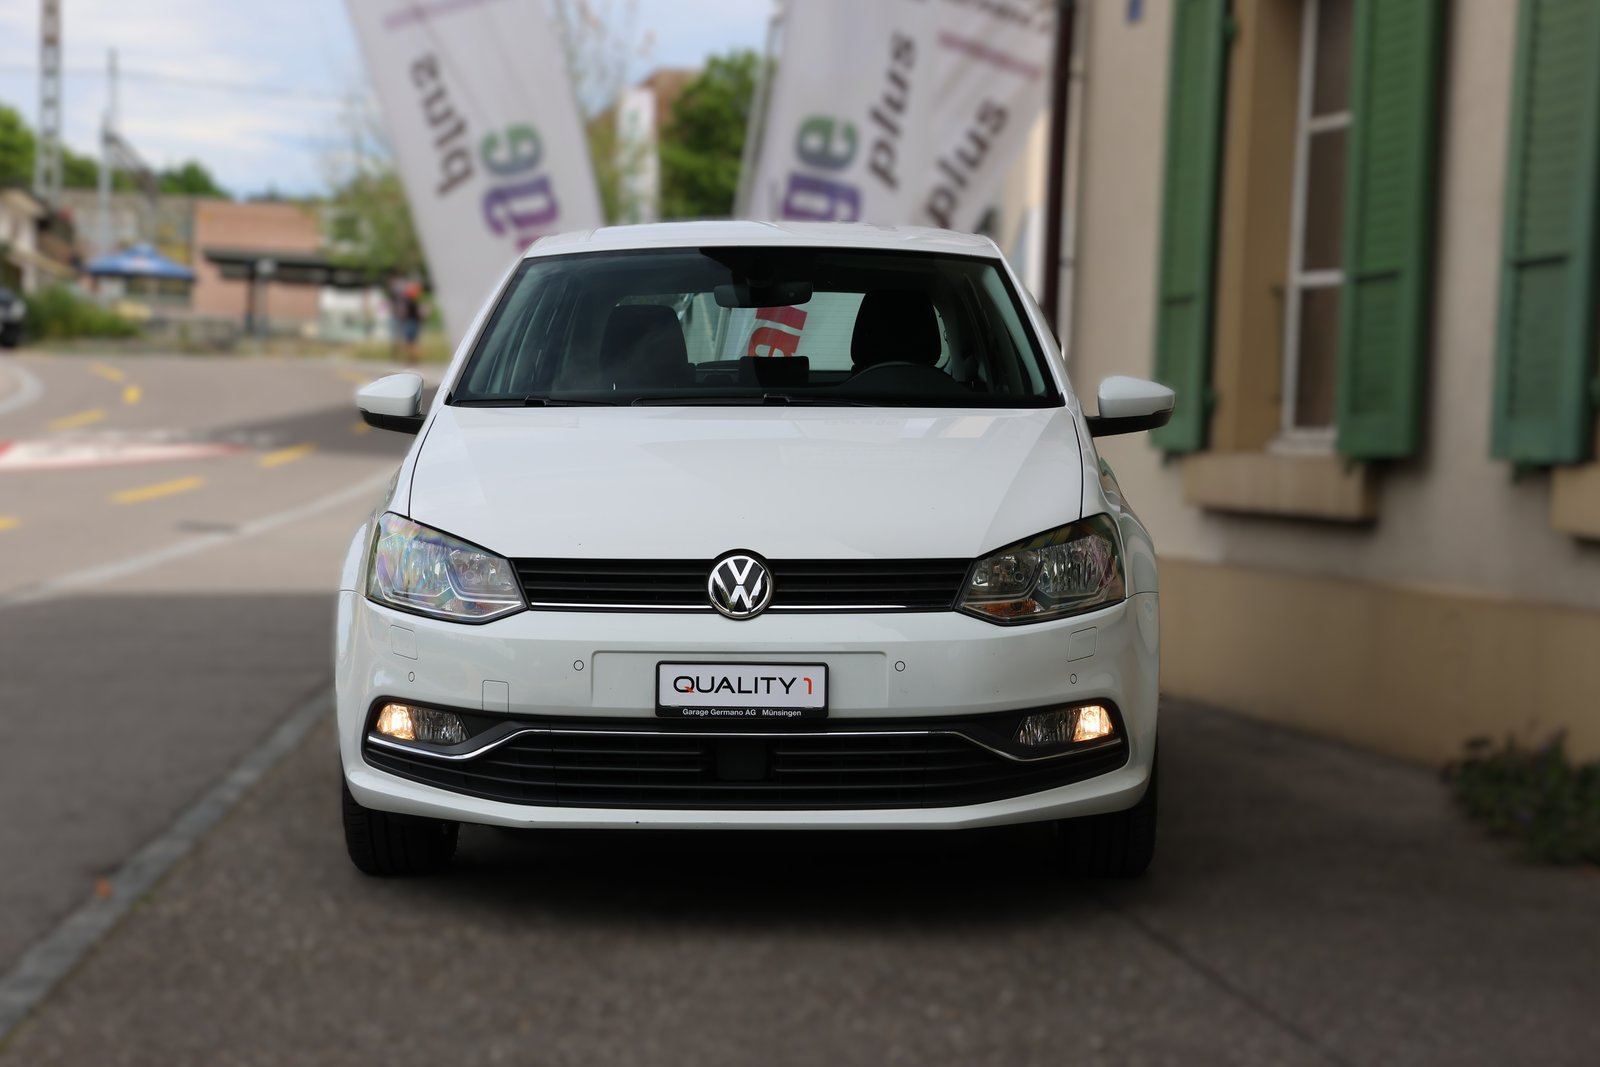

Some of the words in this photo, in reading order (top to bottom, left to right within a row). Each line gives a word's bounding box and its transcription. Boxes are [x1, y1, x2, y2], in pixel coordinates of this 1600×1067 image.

[867, 31, 916, 191] plus
[924, 97, 1010, 229] plus
[673, 675, 798, 695] QUALITY
[803, 677, 813, 695] 1
[682, 709, 709, 717] Garage
[762, 708, 801, 718] Münsingen
